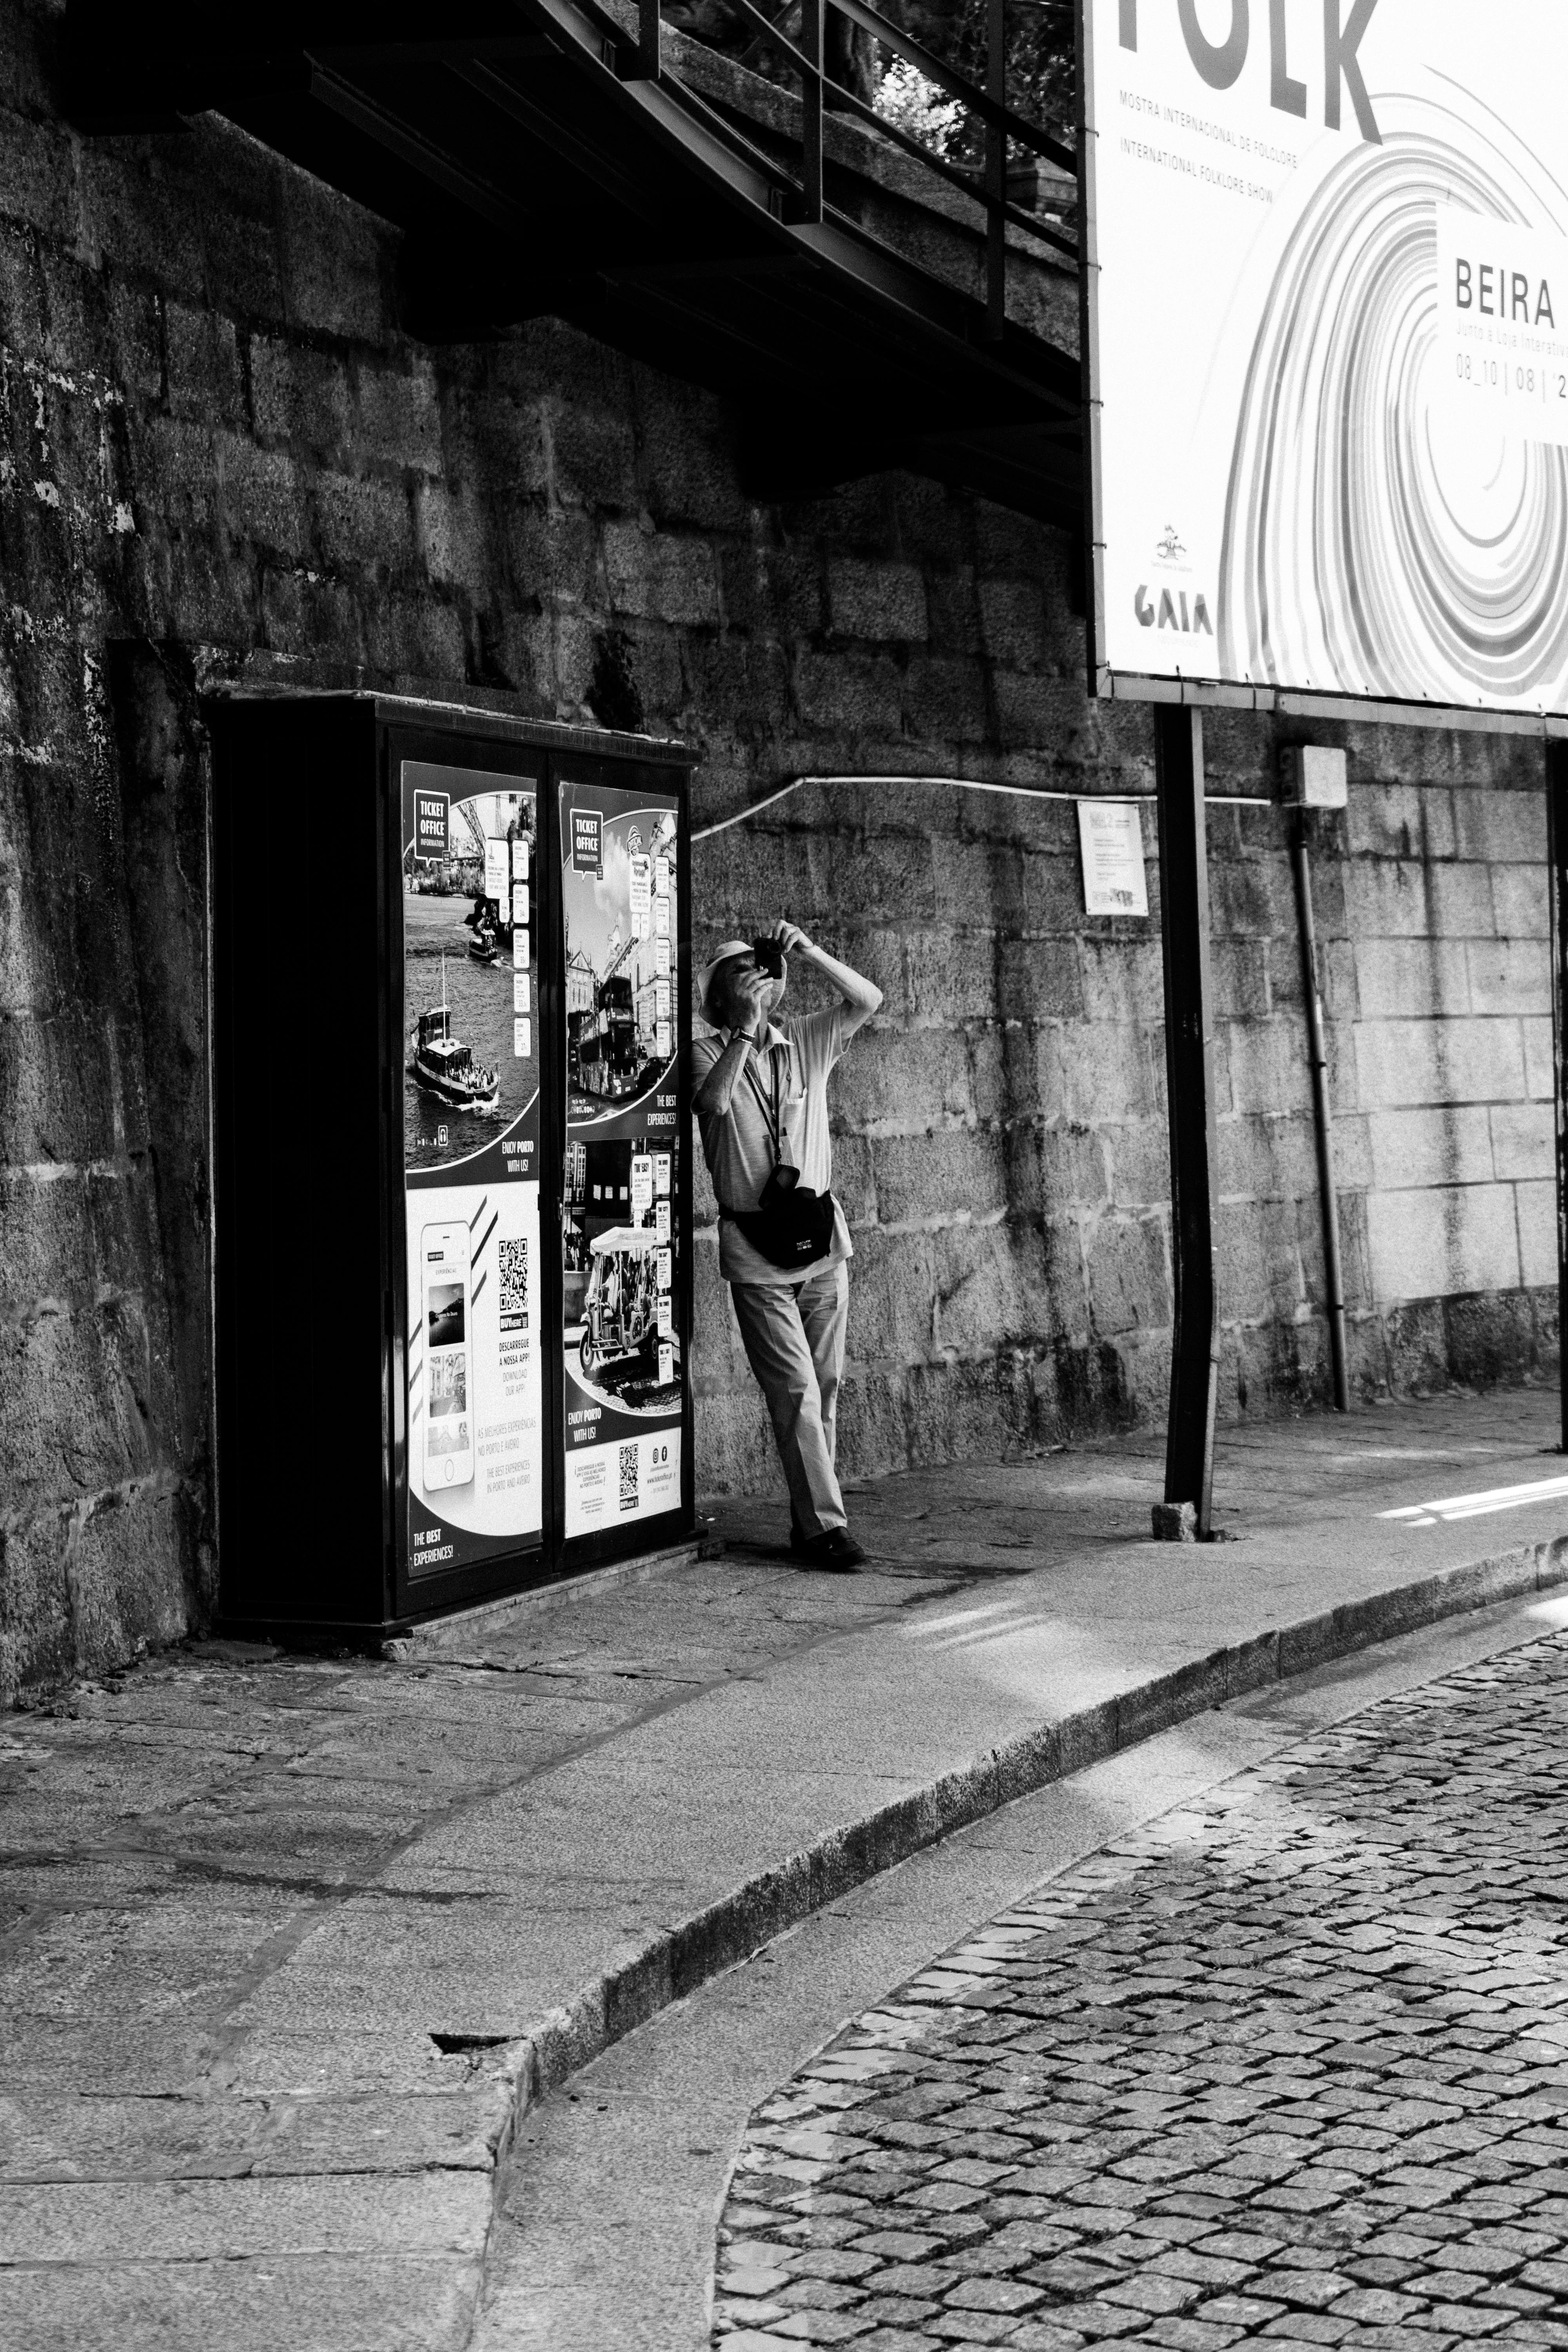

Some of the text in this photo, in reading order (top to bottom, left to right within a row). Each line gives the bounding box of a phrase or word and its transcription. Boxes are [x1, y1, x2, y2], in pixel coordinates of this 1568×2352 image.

[1120, 90, 1297, 169] MOSTRA INTERNACIONAL DE FOLCLORE
[1120, 137, 1273, 203] INTERNATIONAL FOLKLORE SHOW
[1455, 257, 1555, 329] BEIRA
[1134, 584, 1213, 635] GAIA
[420, 801, 444, 817] TICKET
[420, 819, 444, 836] OFFICE
[576, 819, 597, 834] TICKET
[421, 838, 444, 847] INFORMATION
[576, 836, 598, 851] OFFICE
[666, 1095, 676, 1106] BEST
[648, 1113, 676, 1125] EXPERIENCES!
[502, 1140, 534, 1154] ENJOY PORTO
[507, 1160, 520, 1172] WITH
[499, 1339, 529, 1352] DESCARREGUE
[499, 1353, 530, 1366] A NOSSA APP!
[503, 1369, 527, 1382] DOWNLOAD
[506, 1385, 514, 1396] OUR
[568, 1407, 601, 1425] ENJOY PORTO
[478, 1417, 536, 1439] AS MELHORES EXPERIÊNCIAS
[573, 1428, 587, 1442] WITH
[478, 1438, 519, 1456] NO PORTO E AVEIRO
[495, 1465, 504, 1477] BEST
[506, 1459, 530, 1474] EXPERIENCES
[487, 1474, 530, 1493] IN PORTO AND AVEIRO
[414, 1528, 441, 1546] THE BEST
[414, 1545, 453, 1566] EXPERIENCES!
